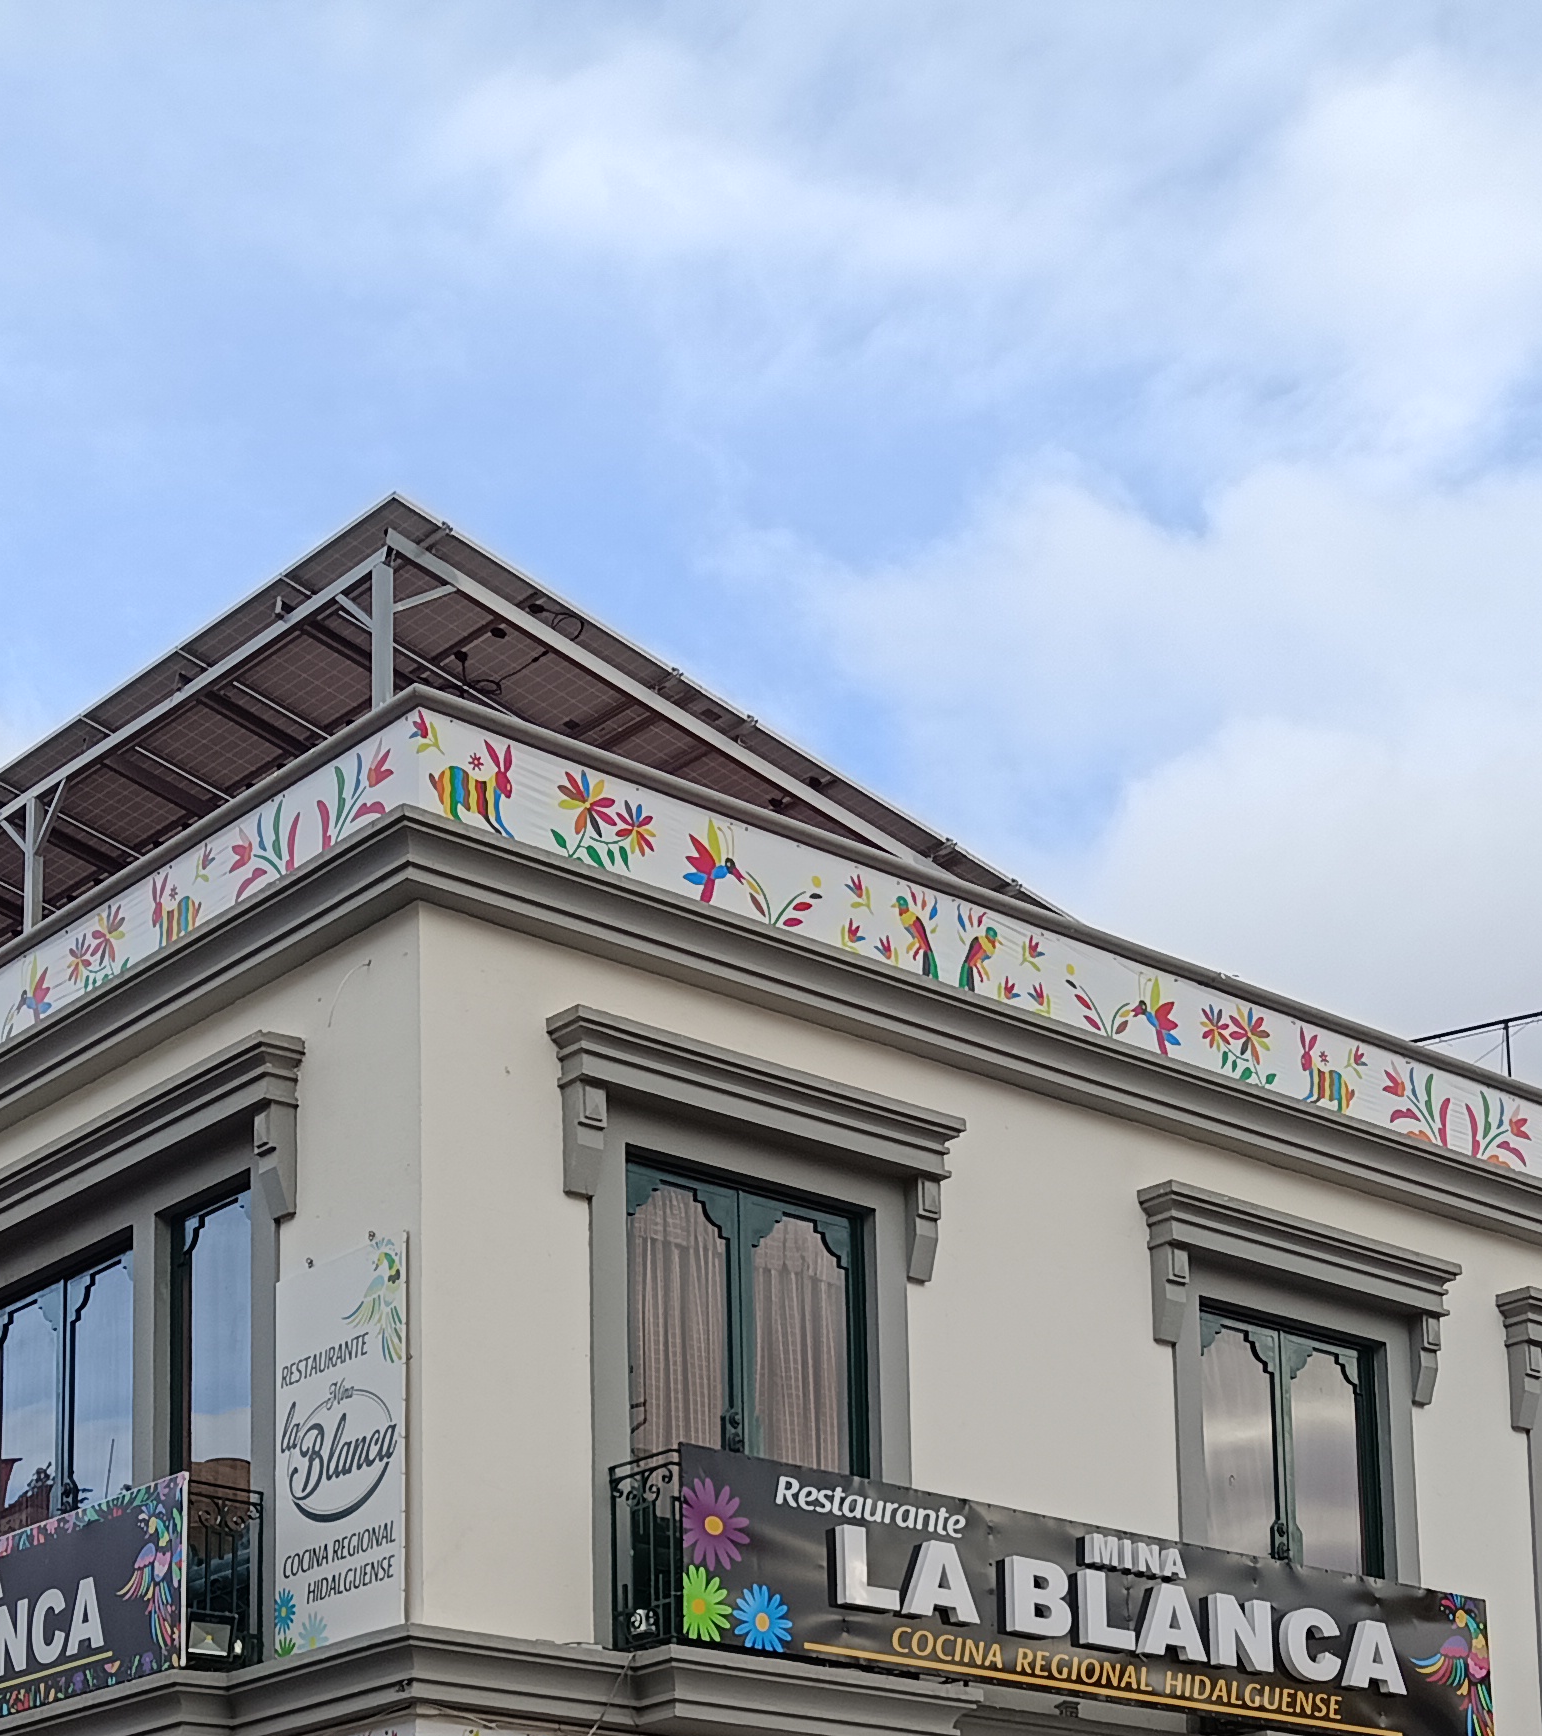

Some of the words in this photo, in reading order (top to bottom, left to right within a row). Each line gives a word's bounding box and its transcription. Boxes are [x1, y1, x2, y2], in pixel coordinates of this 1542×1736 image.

[281, 1332, 369, 1389] RESTAURANTE
[326, 1377, 354, 1410] Mina
[281, 1401, 301, 1453] la
[289, 1412, 397, 1501] Blanca
[775, 1475, 966, 1538] Restaurante
[283, 1543, 329, 1579] COCINA
[332, 1520, 396, 1563] REGIONAL
[1085, 1533, 1186, 1580] MINA
[307, 1555, 395, 1604] HIDALGUENSE
[830, 1525, 980, 1625] LA
[999, 1554, 1407, 1695] BLANCA
[892, 1626, 1003, 1669] COCINA
[1016, 1648, 1153, 1692] REGIONAL
[1165, 1670, 1342, 1720] HIDALGUENSE
